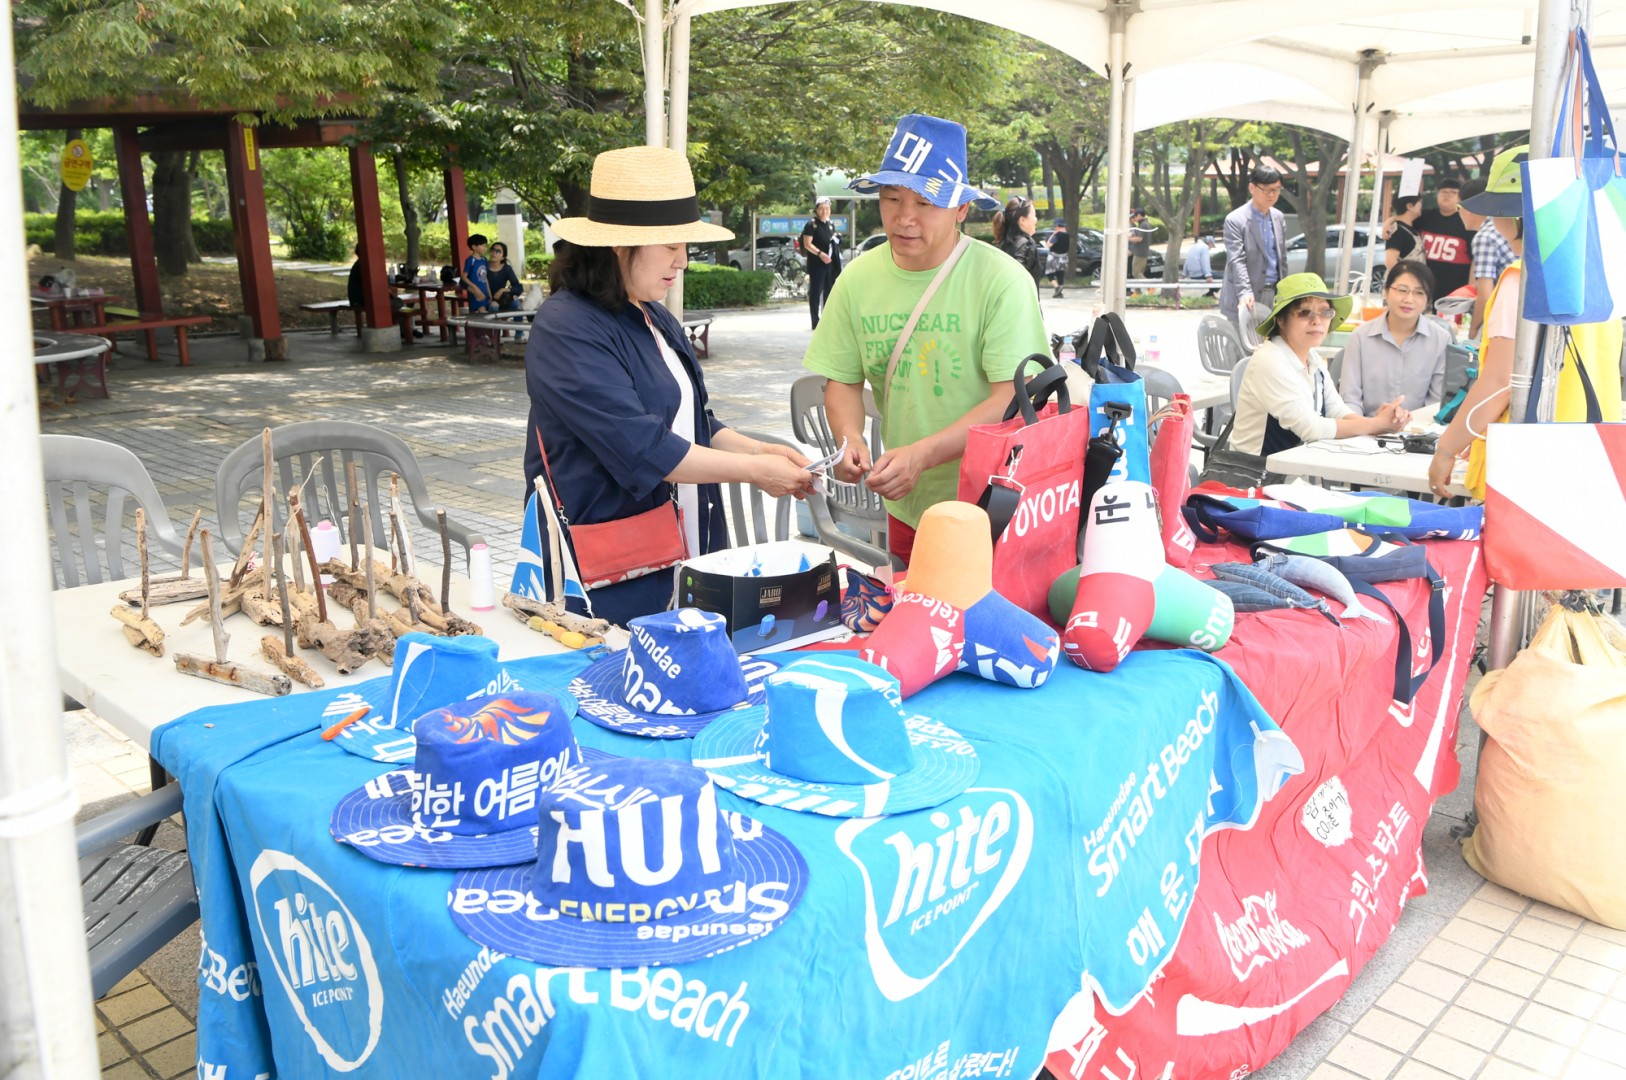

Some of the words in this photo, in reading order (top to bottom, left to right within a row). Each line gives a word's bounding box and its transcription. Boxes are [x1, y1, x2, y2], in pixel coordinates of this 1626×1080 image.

[1082, 771, 1137, 854] Haeundae
[1087, 760, 1167, 898] Smart
[1159, 688, 1219, 788] Beach
[882, 800, 1011, 929] hite
[273, 892, 358, 990] hite
[910, 909, 934, 936] ICE
[463, 966, 600, 1080] Smart
[610, 966, 750, 1048] Beach
